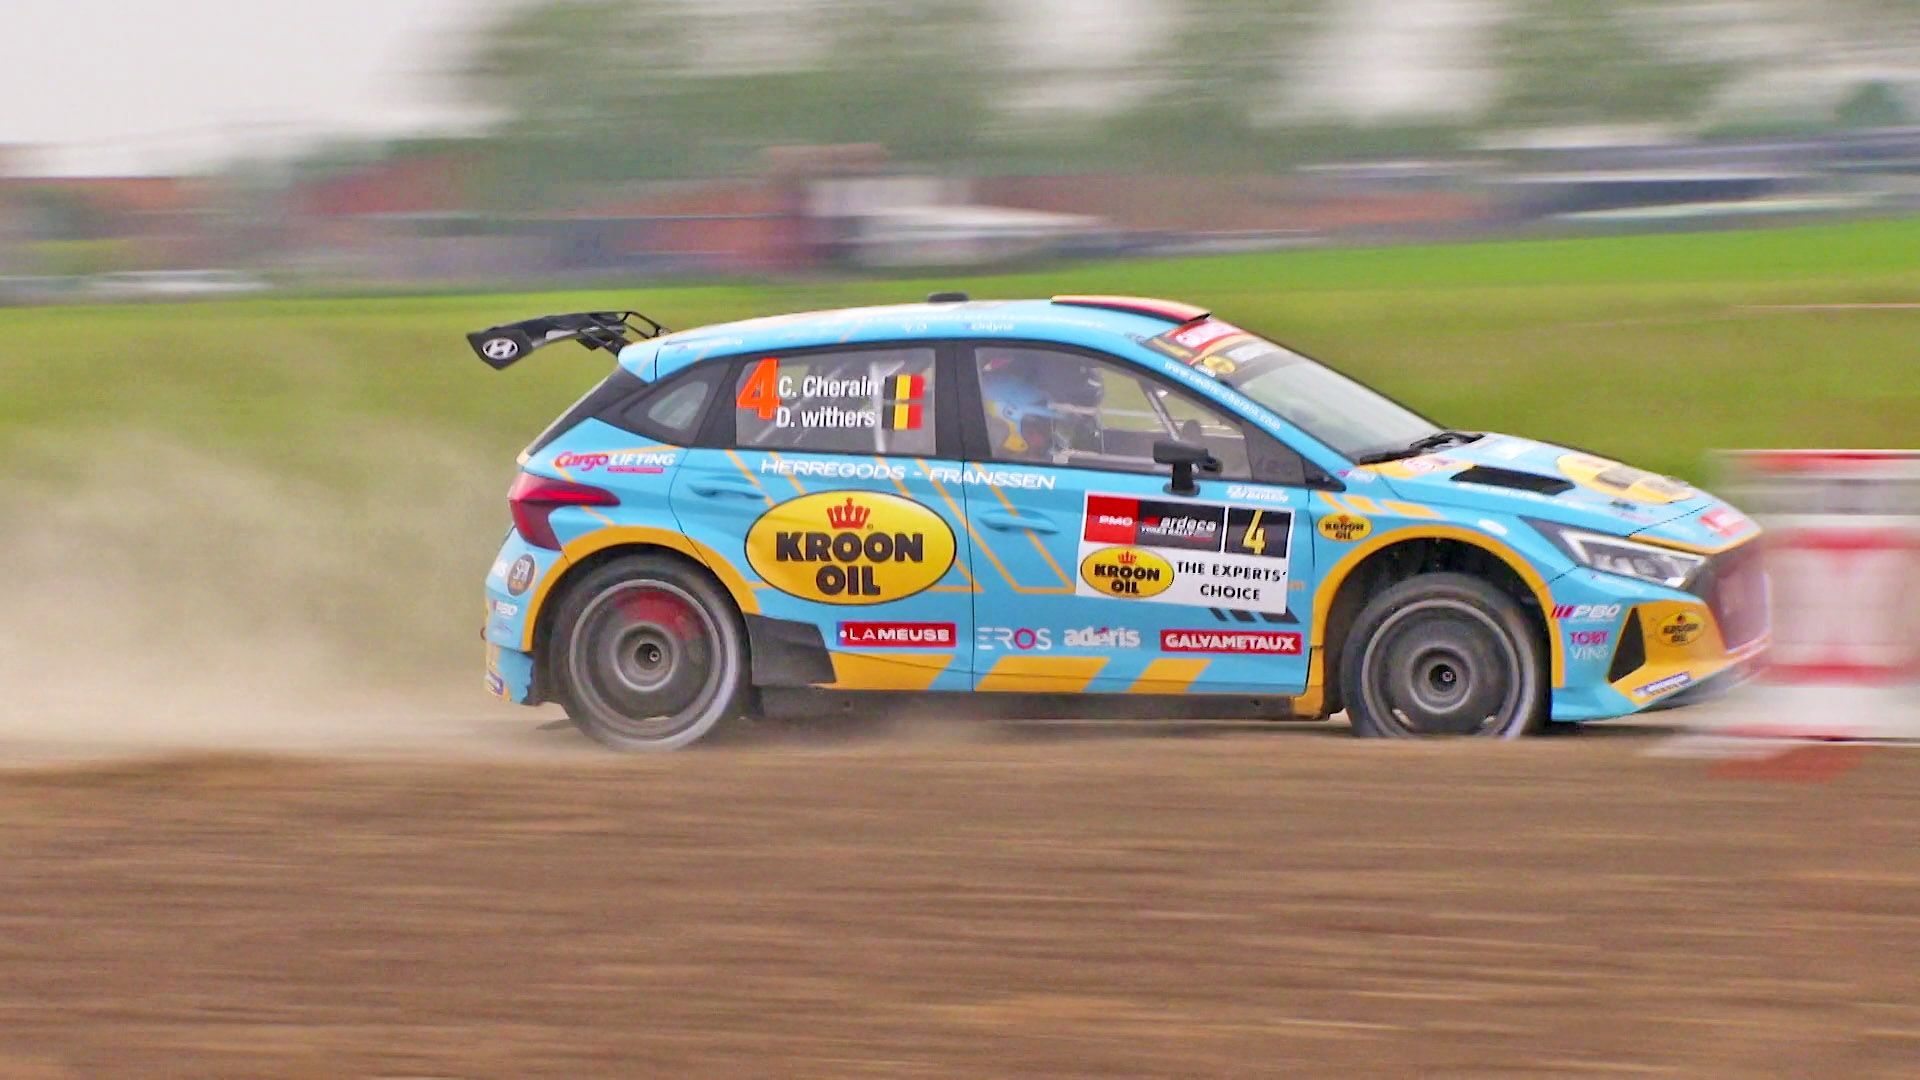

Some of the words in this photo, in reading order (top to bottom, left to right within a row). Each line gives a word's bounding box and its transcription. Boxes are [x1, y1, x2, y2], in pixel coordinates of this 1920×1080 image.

[736, 357, 781, 420] 4
[778, 375, 797, 398] C.
[802, 375, 878, 398] Cherain
[776, 407, 795, 428] D.
[800, 406, 876, 428] withers
[555, 451, 609, 471] Cargo
[610, 453, 676, 466] LIFTING
[761, 459, 906, 480] HERREGODS
[928, 467, 1057, 490] FRANSSEN
[1160, 516, 1217, 532] ardeca
[1241, 509, 1266, 555] 4
[1324, 522, 1364, 532] KROON
[1335, 531, 1353, 540] OIL
[776, 531, 924, 563] KROON
[1094, 563, 1160, 581] KROON
[1177, 561, 1205, 575] THE
[816, 564, 881, 596] OIL
[1111, 580, 1139, 594] OIL
[1199, 584, 1261, 601] CHOICE
[849, 627, 950, 642] LAMEUSE
[977, 627, 1052, 650] EROS
